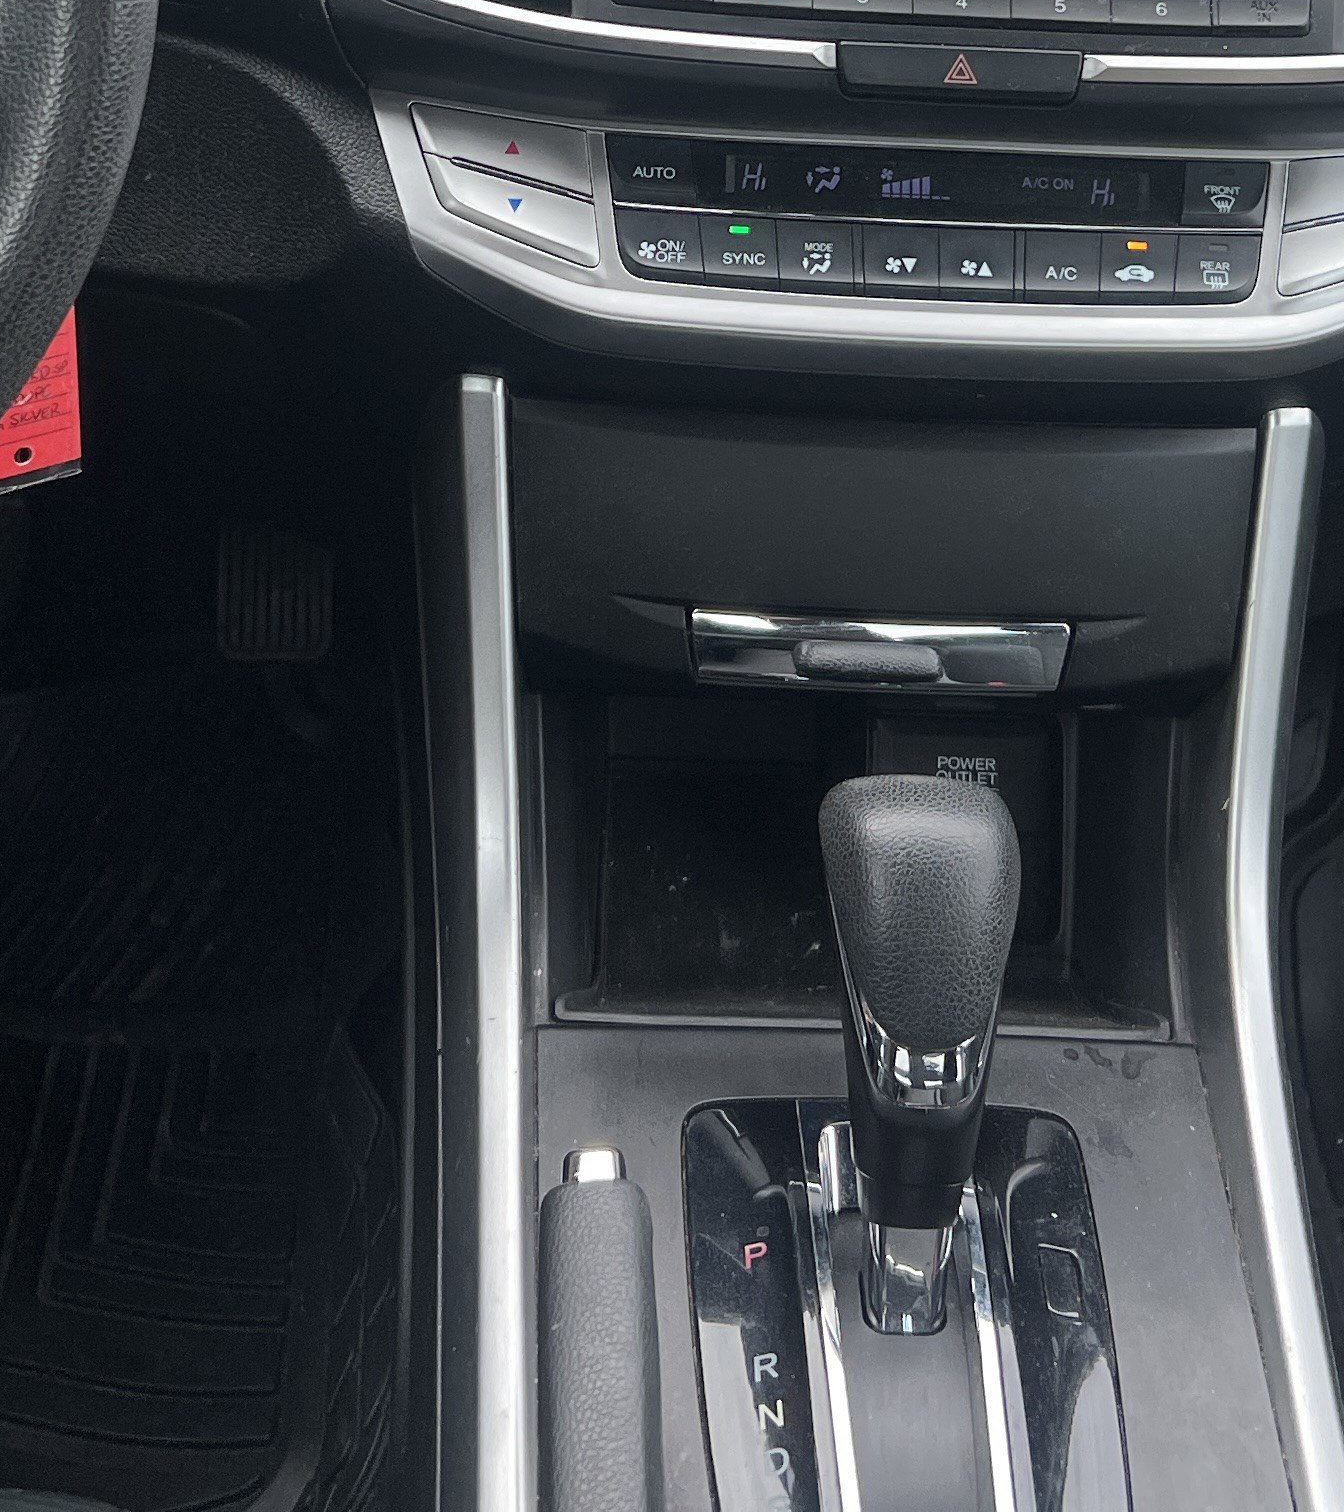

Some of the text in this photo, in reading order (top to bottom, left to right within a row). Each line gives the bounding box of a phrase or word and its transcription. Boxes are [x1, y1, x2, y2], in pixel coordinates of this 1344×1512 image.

[1156, 1, 1168, 16] 6
[632, 165, 677, 180] AUTO
[1021, 177, 1075, 190] A/C ON
[1203, 184, 1242, 196] FRONT
[657, 239, 686, 252] ON/
[804, 242, 835, 253] MODE
[655, 251, 687, 264] OFF
[721, 252, 767, 266] SYNC
[1199, 260, 1231, 271] REAR
[1044, 266, 1079, 281] A/C
[937, 755, 997, 771] POWER
[744, 1241, 768, 1271] P
[753, 1352, 779, 1383] R
[758, 1399, 785, 1430] N
